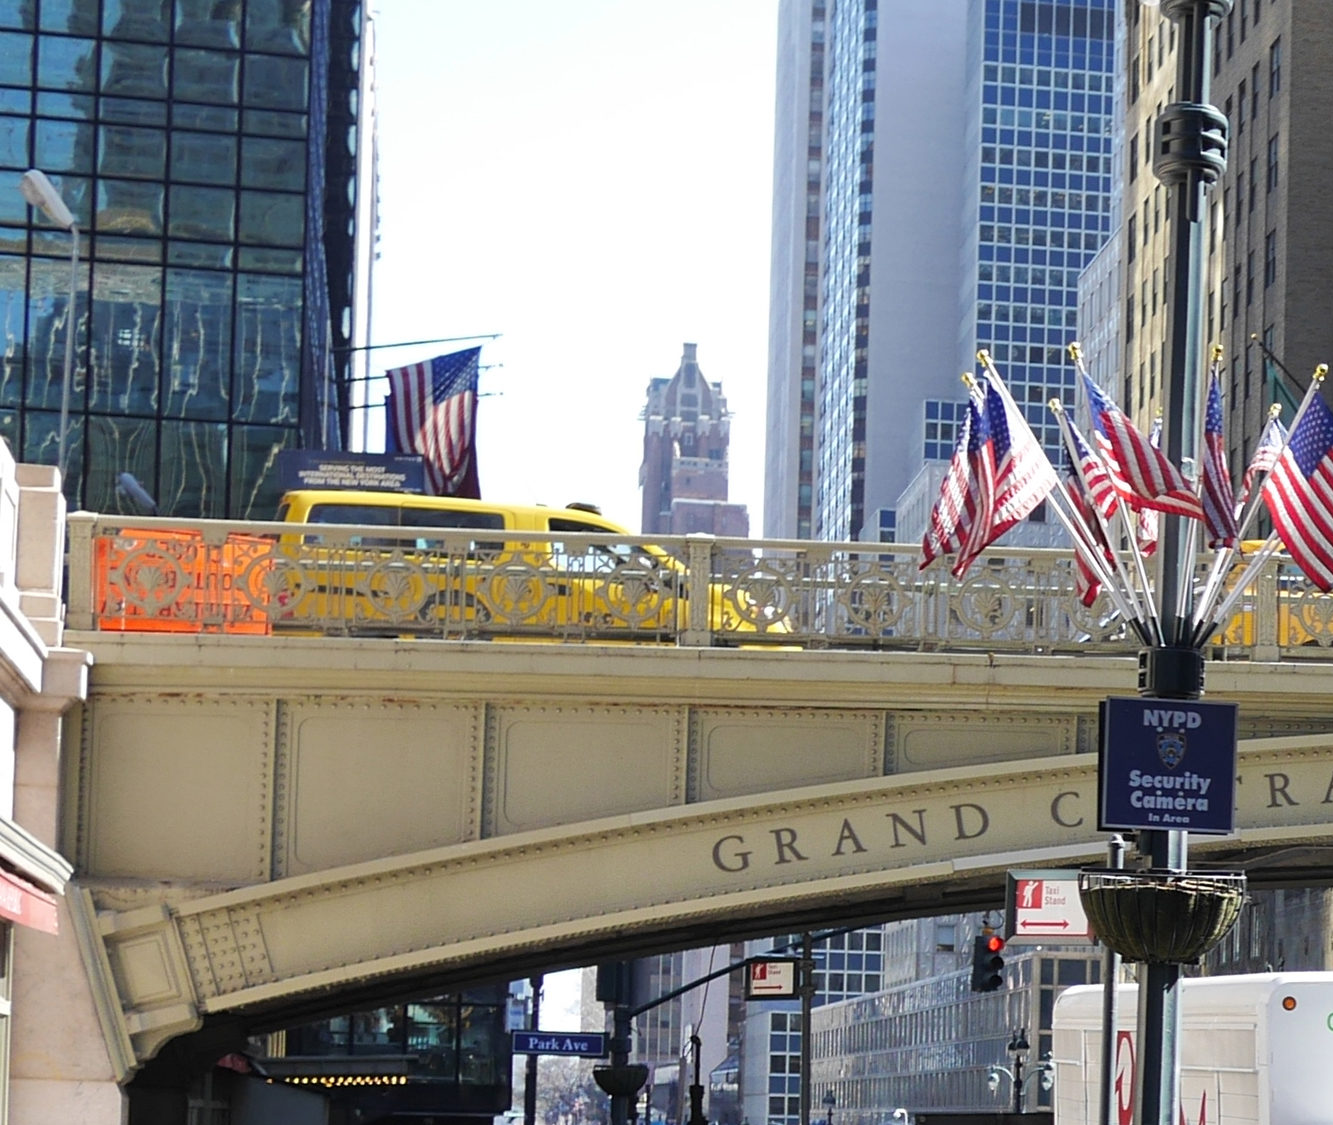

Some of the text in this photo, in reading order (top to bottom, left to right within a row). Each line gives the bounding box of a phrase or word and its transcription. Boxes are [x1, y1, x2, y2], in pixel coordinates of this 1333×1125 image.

[298, 470, 406, 481] INTERNATIONAL DESTINATIONS
[327, 478, 340, 486] THE
[360, 479, 380, 487] YORK
[1143, 709, 1202, 729] NYPD
[1128, 769, 1212, 795] Security
[1130, 790, 1209, 811] Camera
[1148, 813, 1190, 823] In Area
[711, 802, 990, 873] GRAND
[1045, 886, 1060, 895] Taxi
[1044, 896, 1066, 905] Stand
[528, 1036, 588, 1052] Park Ave
